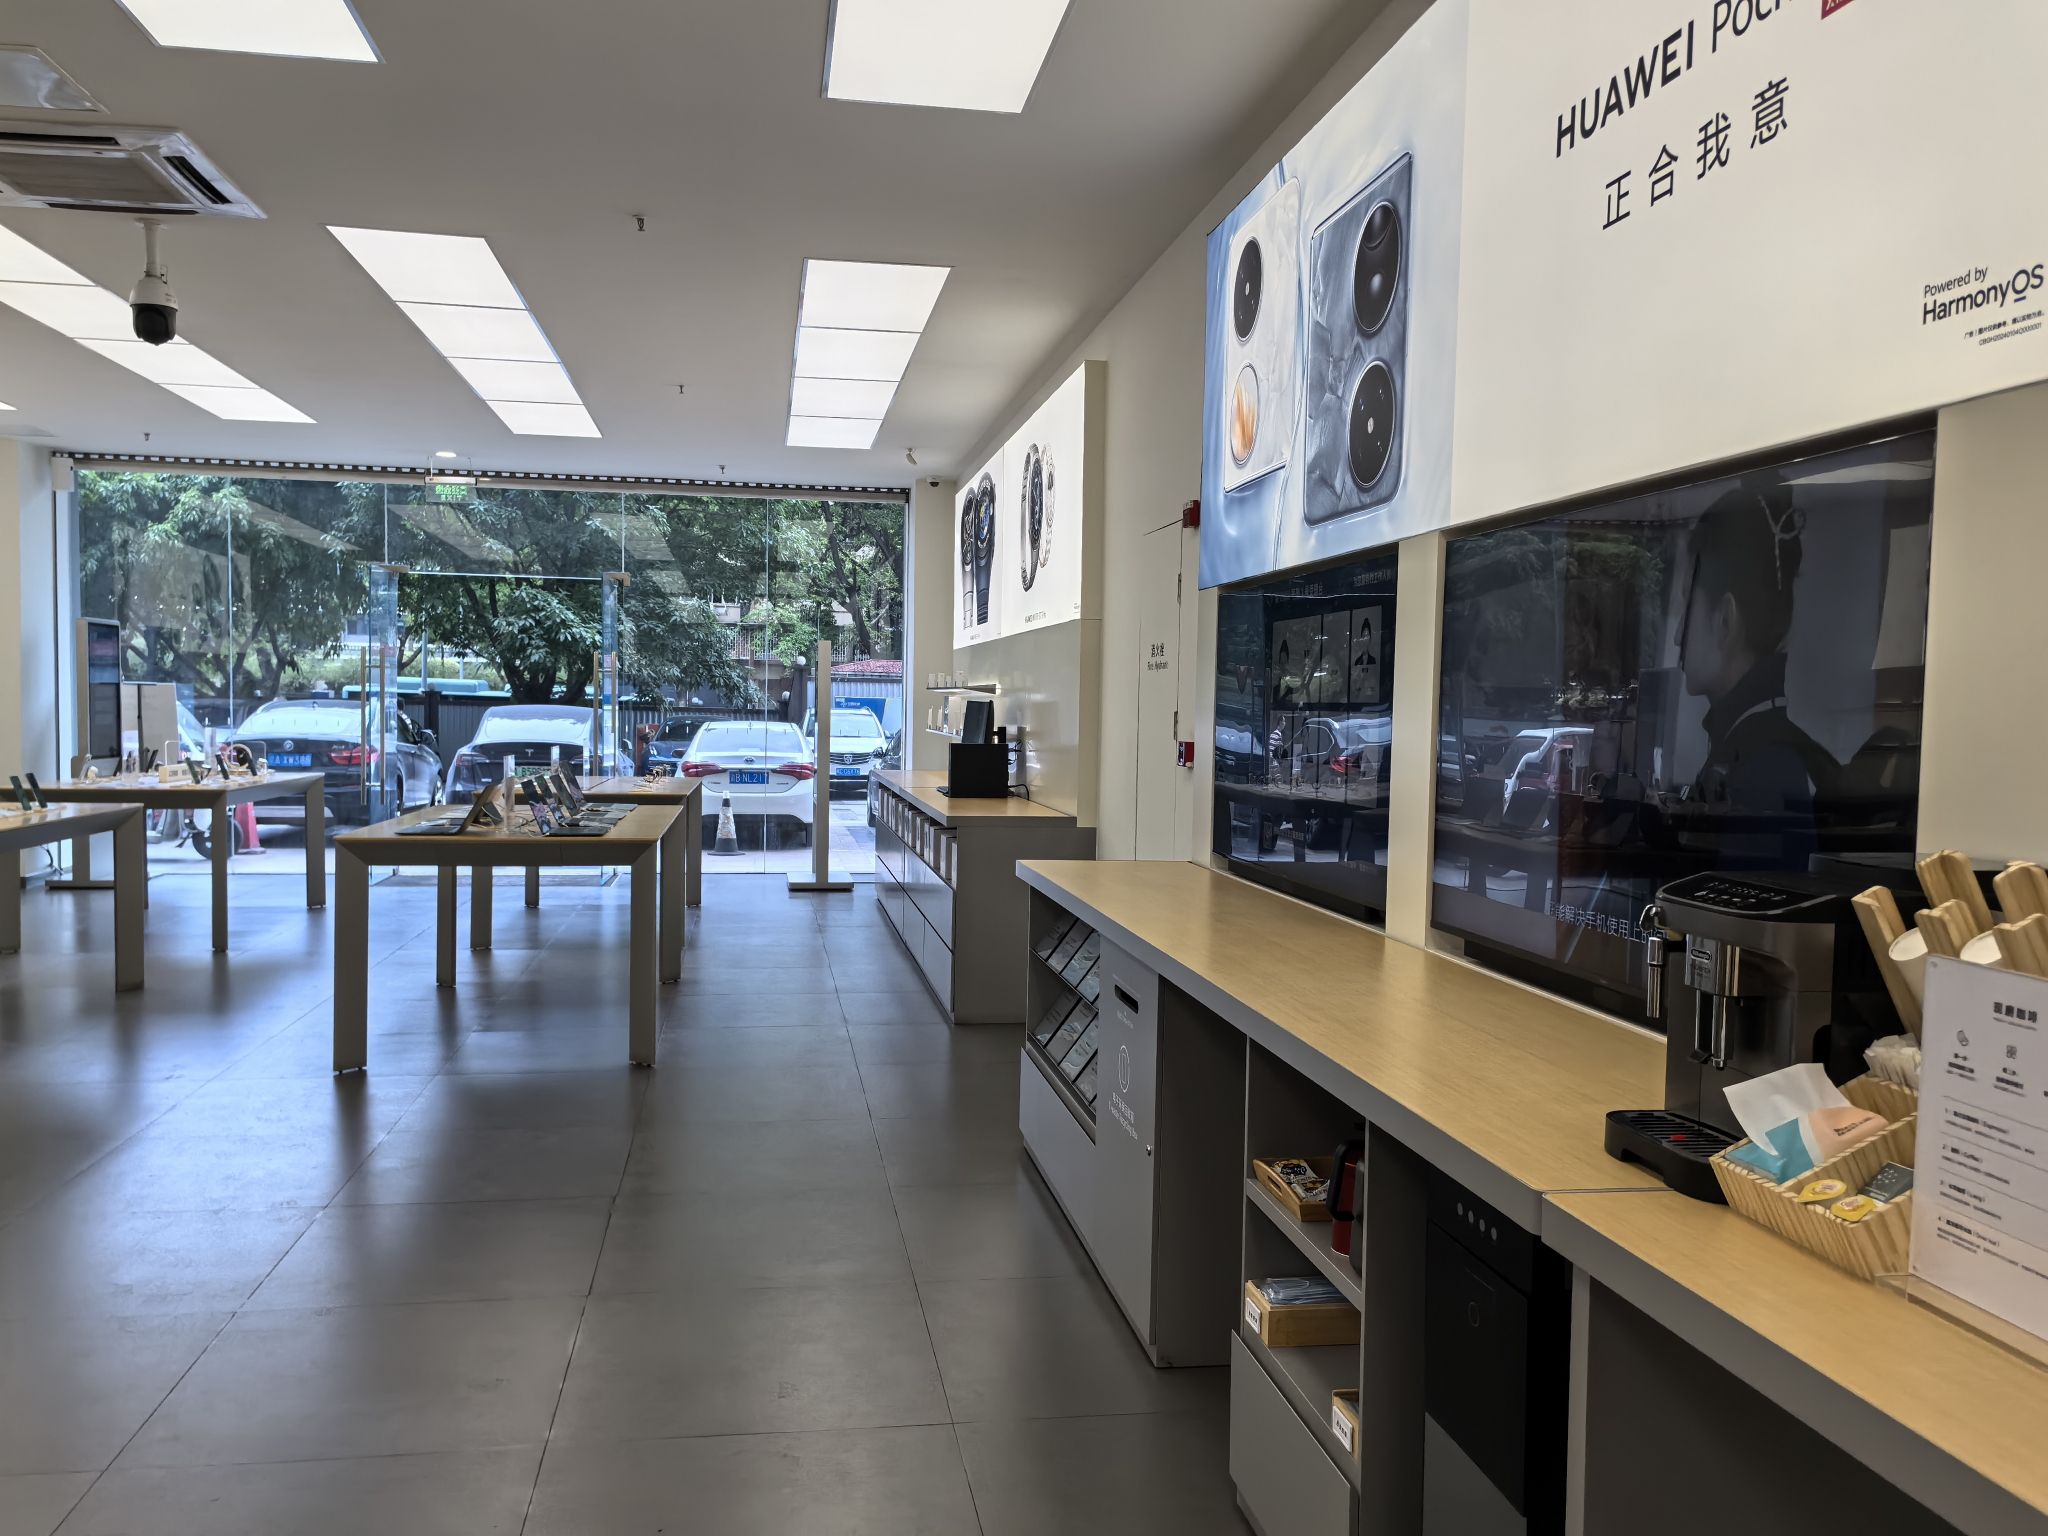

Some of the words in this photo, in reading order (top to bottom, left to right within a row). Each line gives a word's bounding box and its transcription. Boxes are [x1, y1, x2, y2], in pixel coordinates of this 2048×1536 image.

[1555, 18, 1695, 159] HUAWEI
[1602, 76, 1790, 231] 正合我意
[1922, 263, 2045, 326] HarmonyOS
[1923, 269, 1971, 299] Powered
[1974, 265, 1989, 284] by
